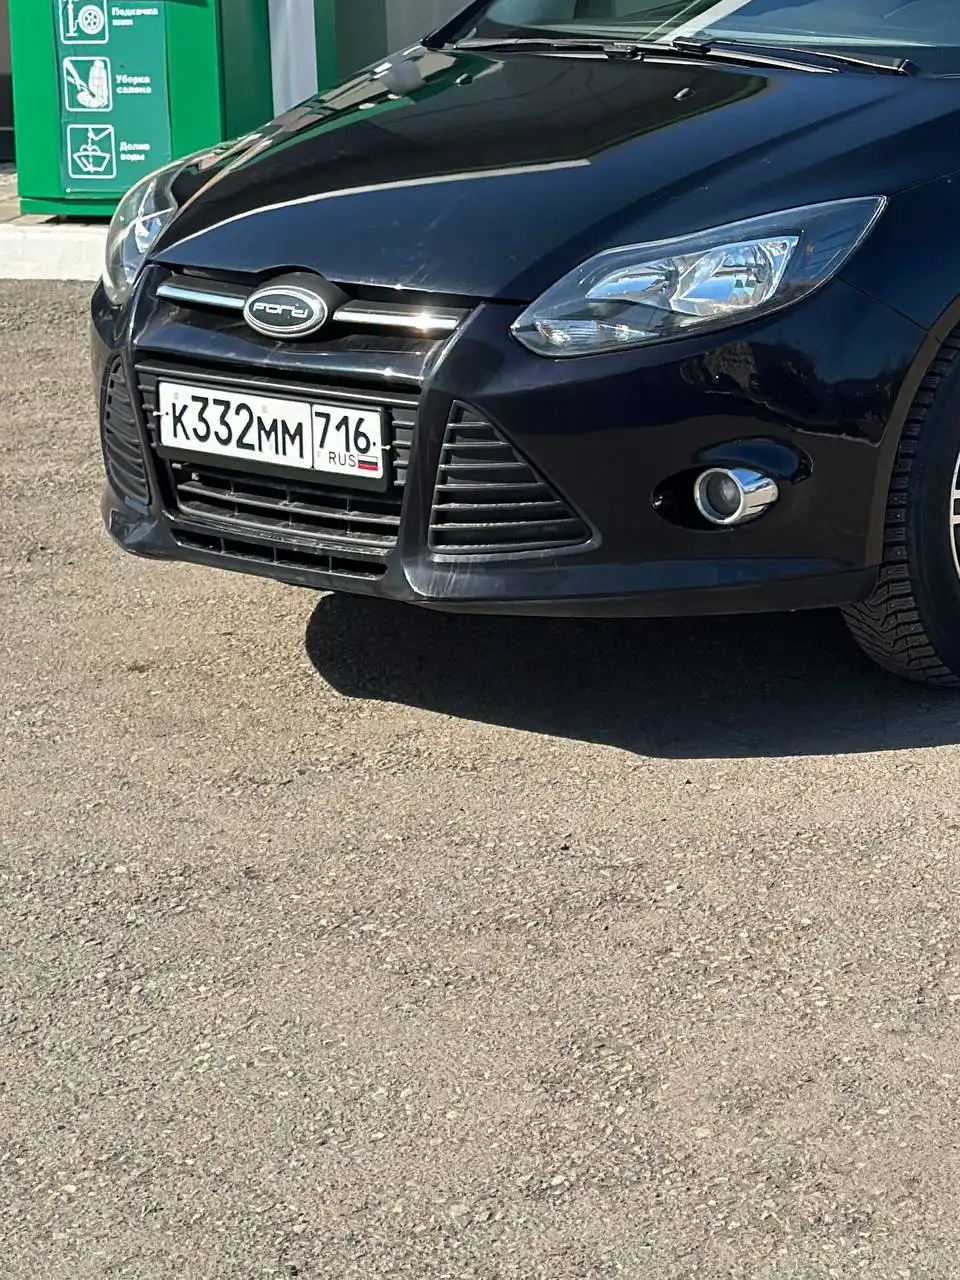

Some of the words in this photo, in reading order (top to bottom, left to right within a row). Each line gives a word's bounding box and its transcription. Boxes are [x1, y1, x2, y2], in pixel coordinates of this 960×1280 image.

[111, 7, 158, 17] Подкачка
[115, 74, 151, 85] Уборка
[116, 86, 152, 94] салона
[252, 302, 309, 319] Ford
[171, 395, 305, 459] К332ММ
[314, 411, 371, 455] 716
[328, 451, 356, 468] RUS
